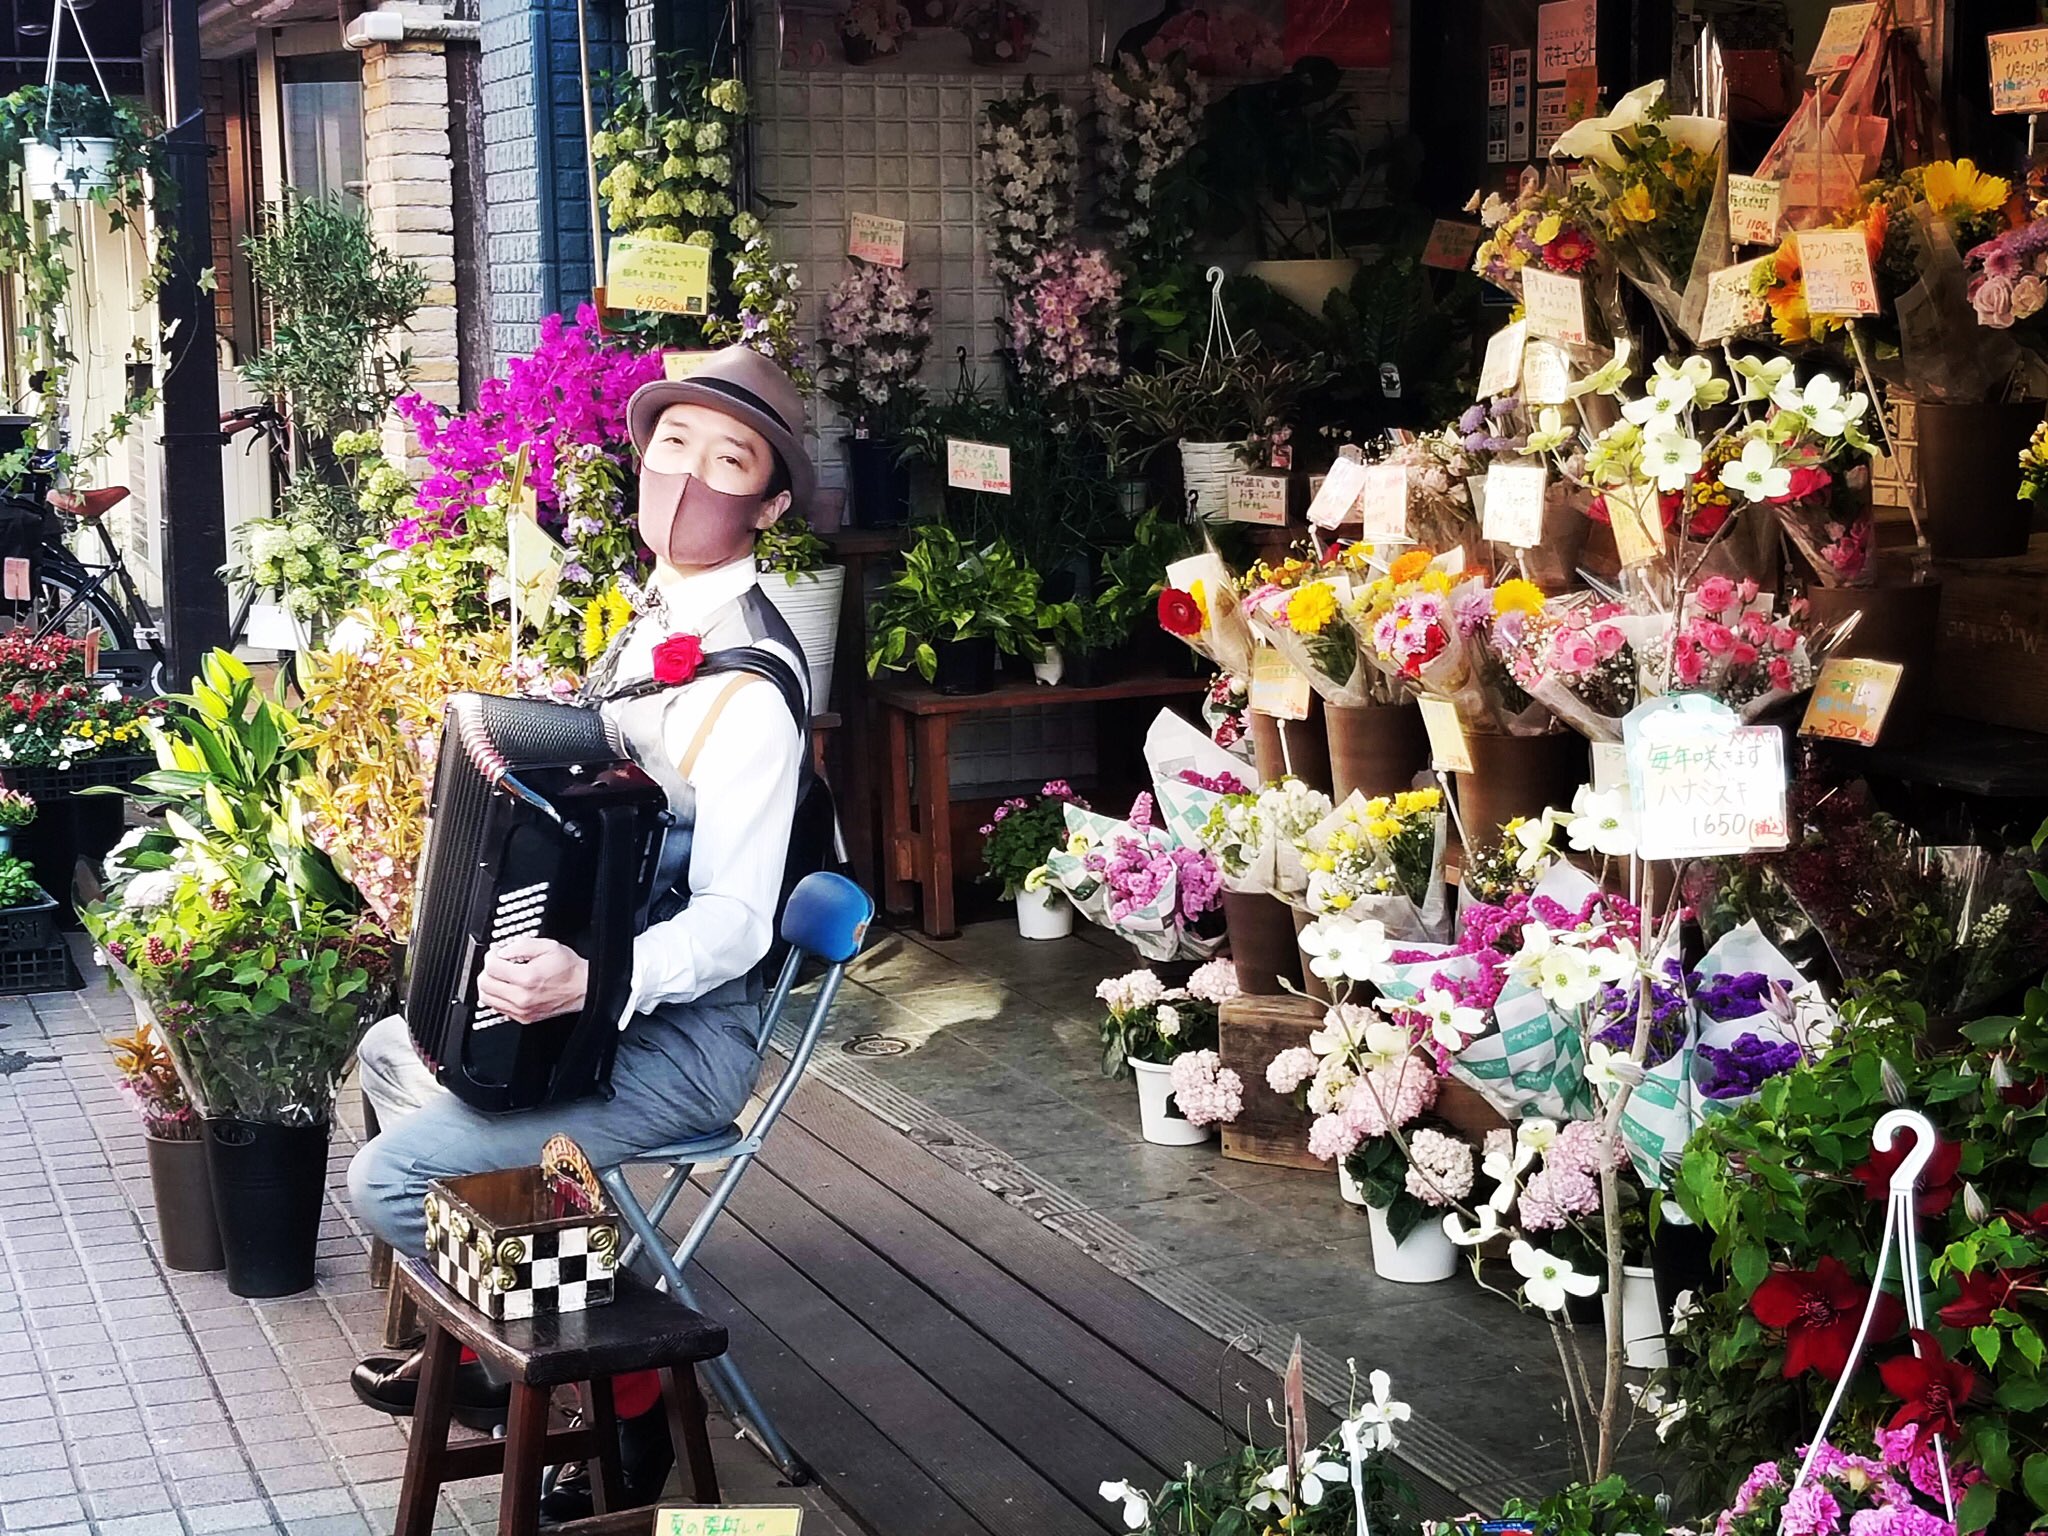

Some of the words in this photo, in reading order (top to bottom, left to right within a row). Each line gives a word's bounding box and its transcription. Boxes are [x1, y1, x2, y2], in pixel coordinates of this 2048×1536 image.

[1648, 743, 1763, 775] 毎年咲きます
[1657, 777, 1749, 808] ハナミズキ
